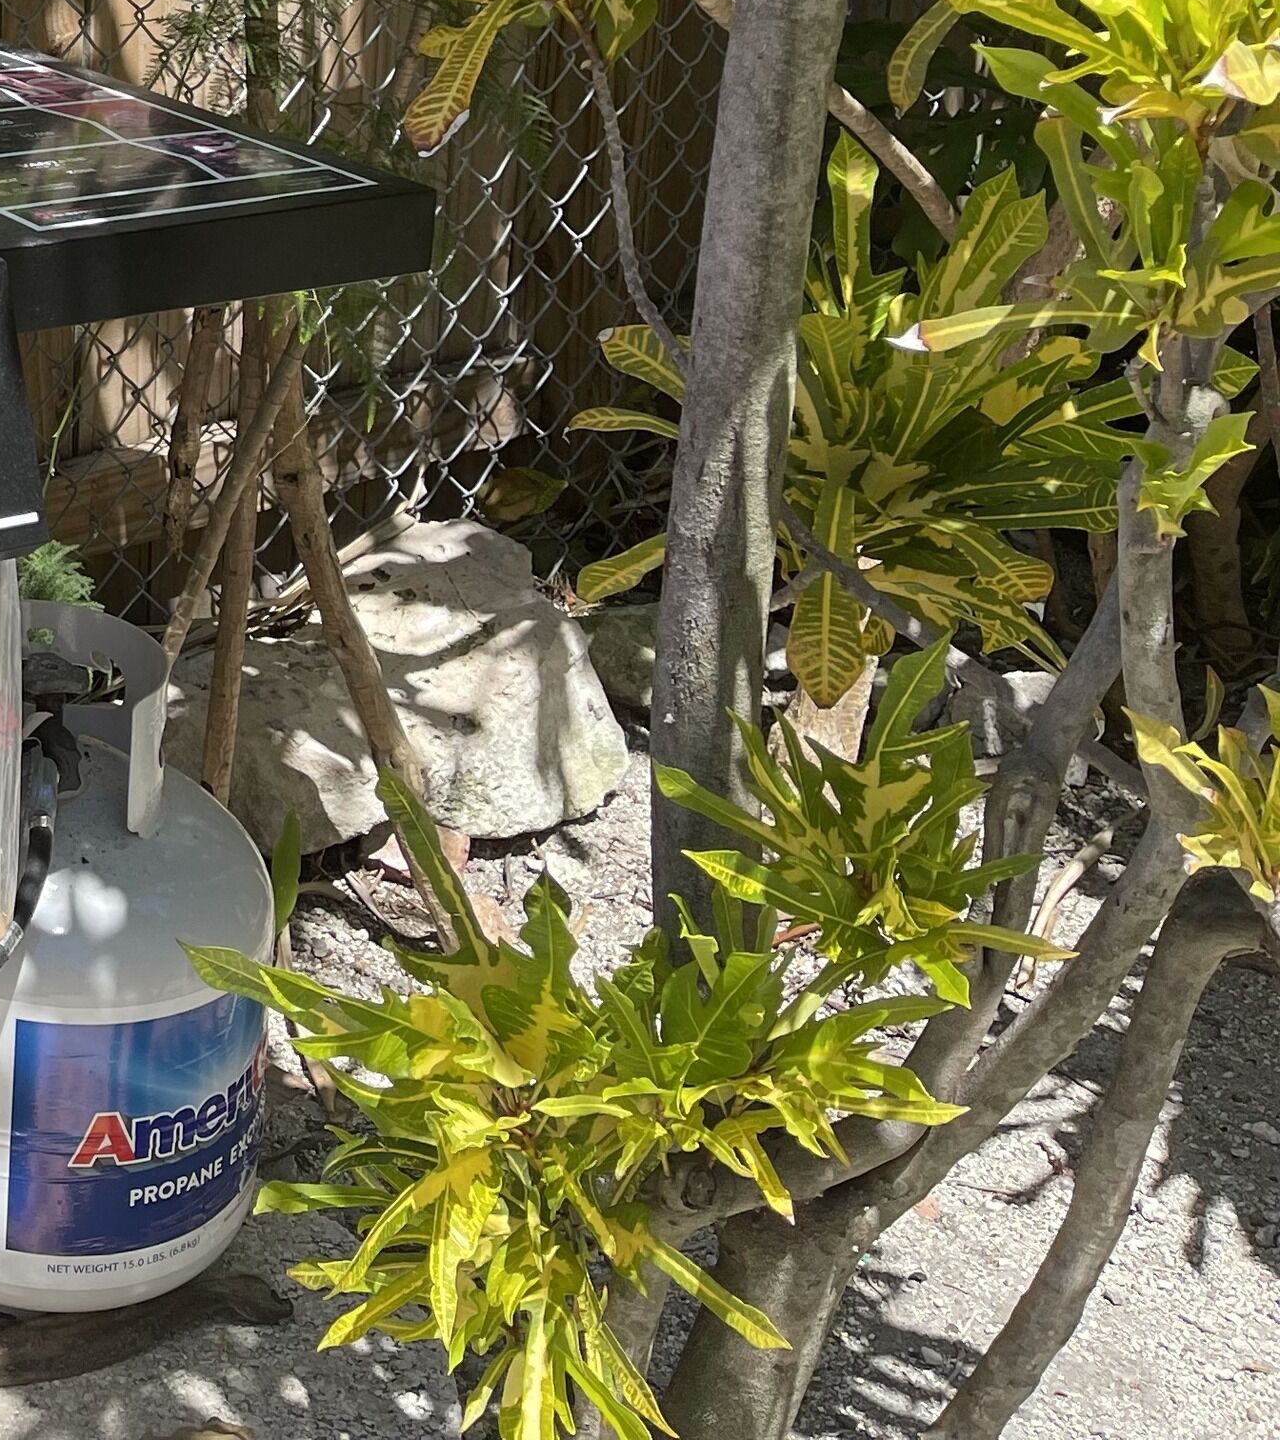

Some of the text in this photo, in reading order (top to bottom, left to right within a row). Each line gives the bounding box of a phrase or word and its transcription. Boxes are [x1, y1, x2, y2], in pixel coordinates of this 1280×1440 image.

[129, 1156, 224, 1207] PROPANE
[47, 1264, 71, 1274] NET
[73, 1262, 119, 1274] WEIGHT
[123, 1258, 145, 1270] 15.0
[146, 1251, 167, 1265] LBS.
